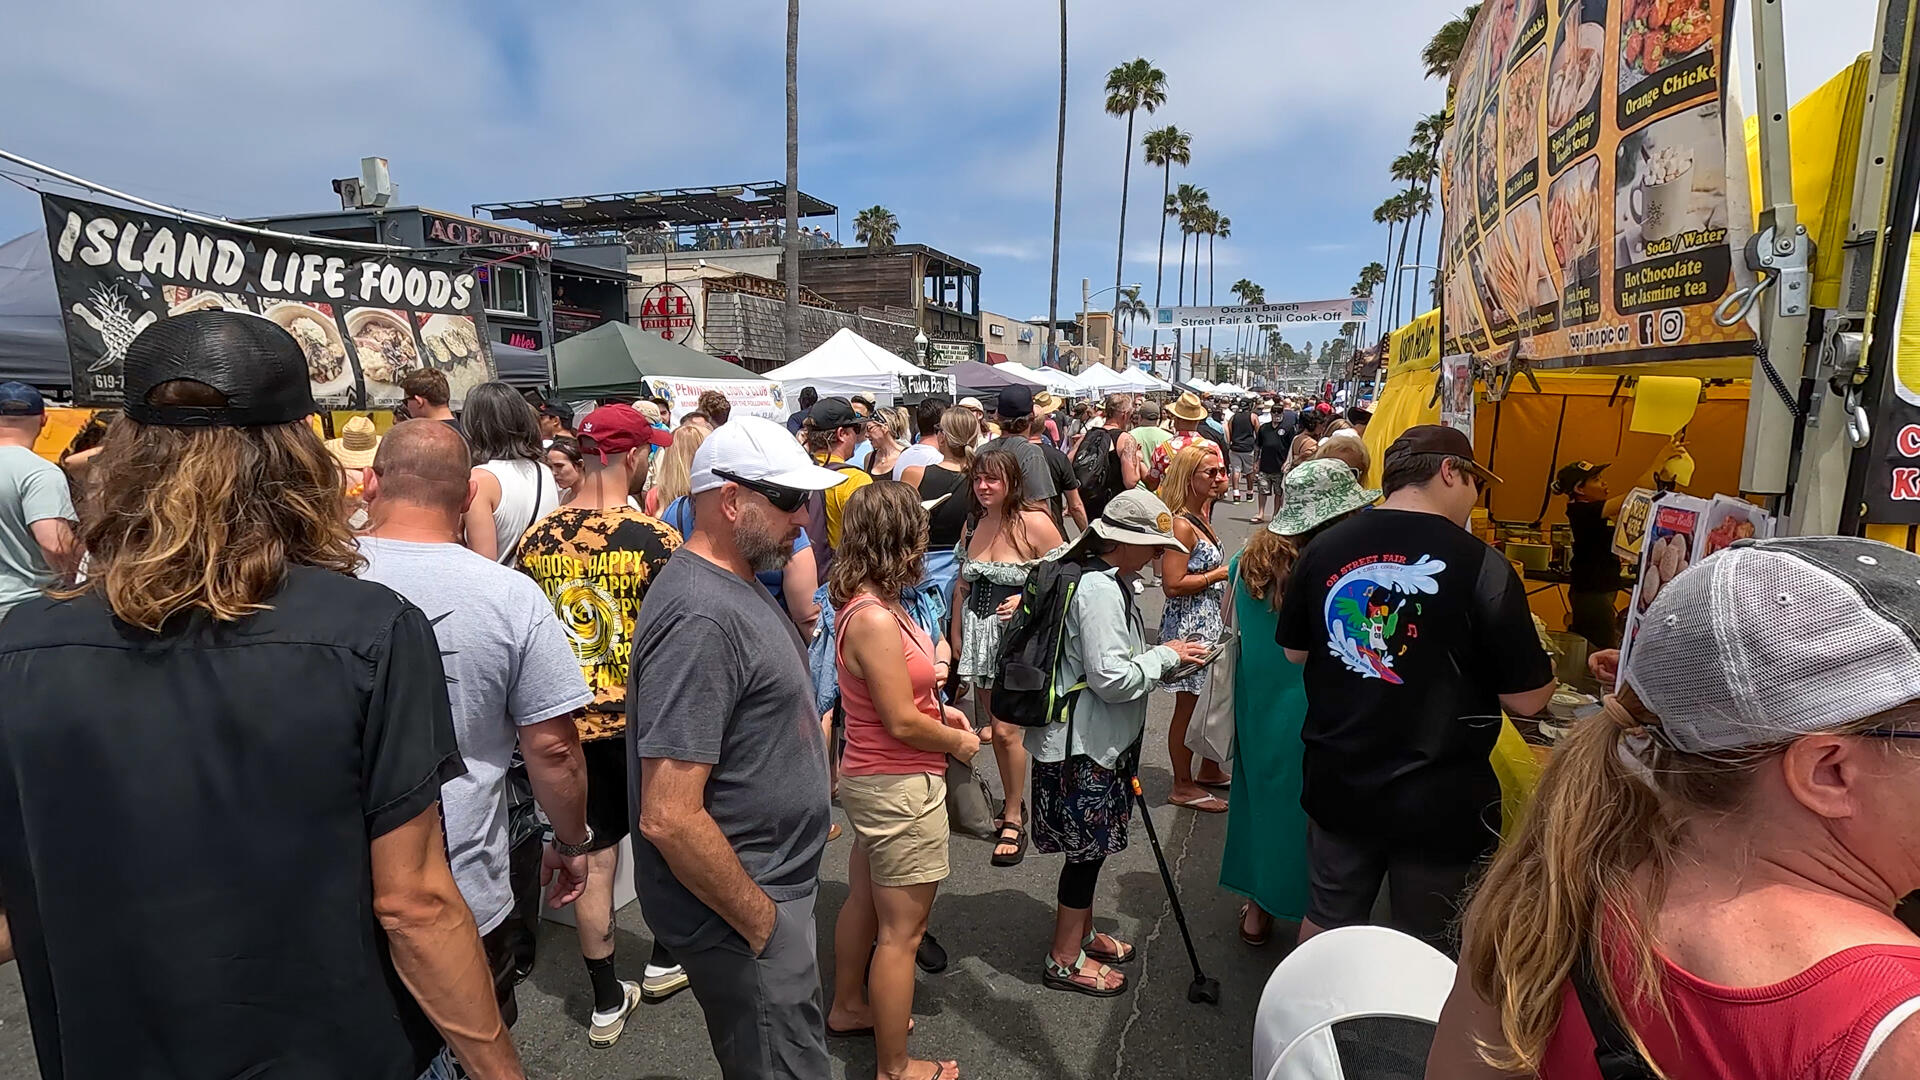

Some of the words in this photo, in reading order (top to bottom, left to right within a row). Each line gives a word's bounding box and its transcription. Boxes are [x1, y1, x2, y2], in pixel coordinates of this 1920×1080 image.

[1625, 87, 1660, 116] Orange
[430, 219, 482, 245] ACE
[1646, 238, 1673, 257] Soda
[1682, 228, 1728, 248] Water
[57, 211, 246, 287] ISLAND
[260, 247, 346, 300] LIFE
[360, 261, 475, 310] FOODS
[1624, 271, 1640, 289] Hot
[1640, 259, 1703, 284] Chocolate
[642, 296, 690, 316] ACE
[1621, 291, 1637, 308] Hot
[1637, 283, 1681, 305] Jasmine
[1684, 280, 1708, 297] tea
[1181, 318, 1216, 327] Street
[1218, 316, 1241, 325] Fair
[1244, 315, 1253, 324] &
[1256, 313, 1283, 323] Chili
[1286, 311, 1342, 322] Cook-Off
[1220, 306, 1258, 314] Ocean
[1262, 303, 1299, 312] Beach
[1617, 325, 1630, 342] on
[588, 550, 645, 577] HAPPY
[1326, 573, 1340, 587] OB
[1340, 554, 1379, 575] STREET
[1382, 553, 1407, 564] FAIR
[593, 574, 642, 599] APPY
